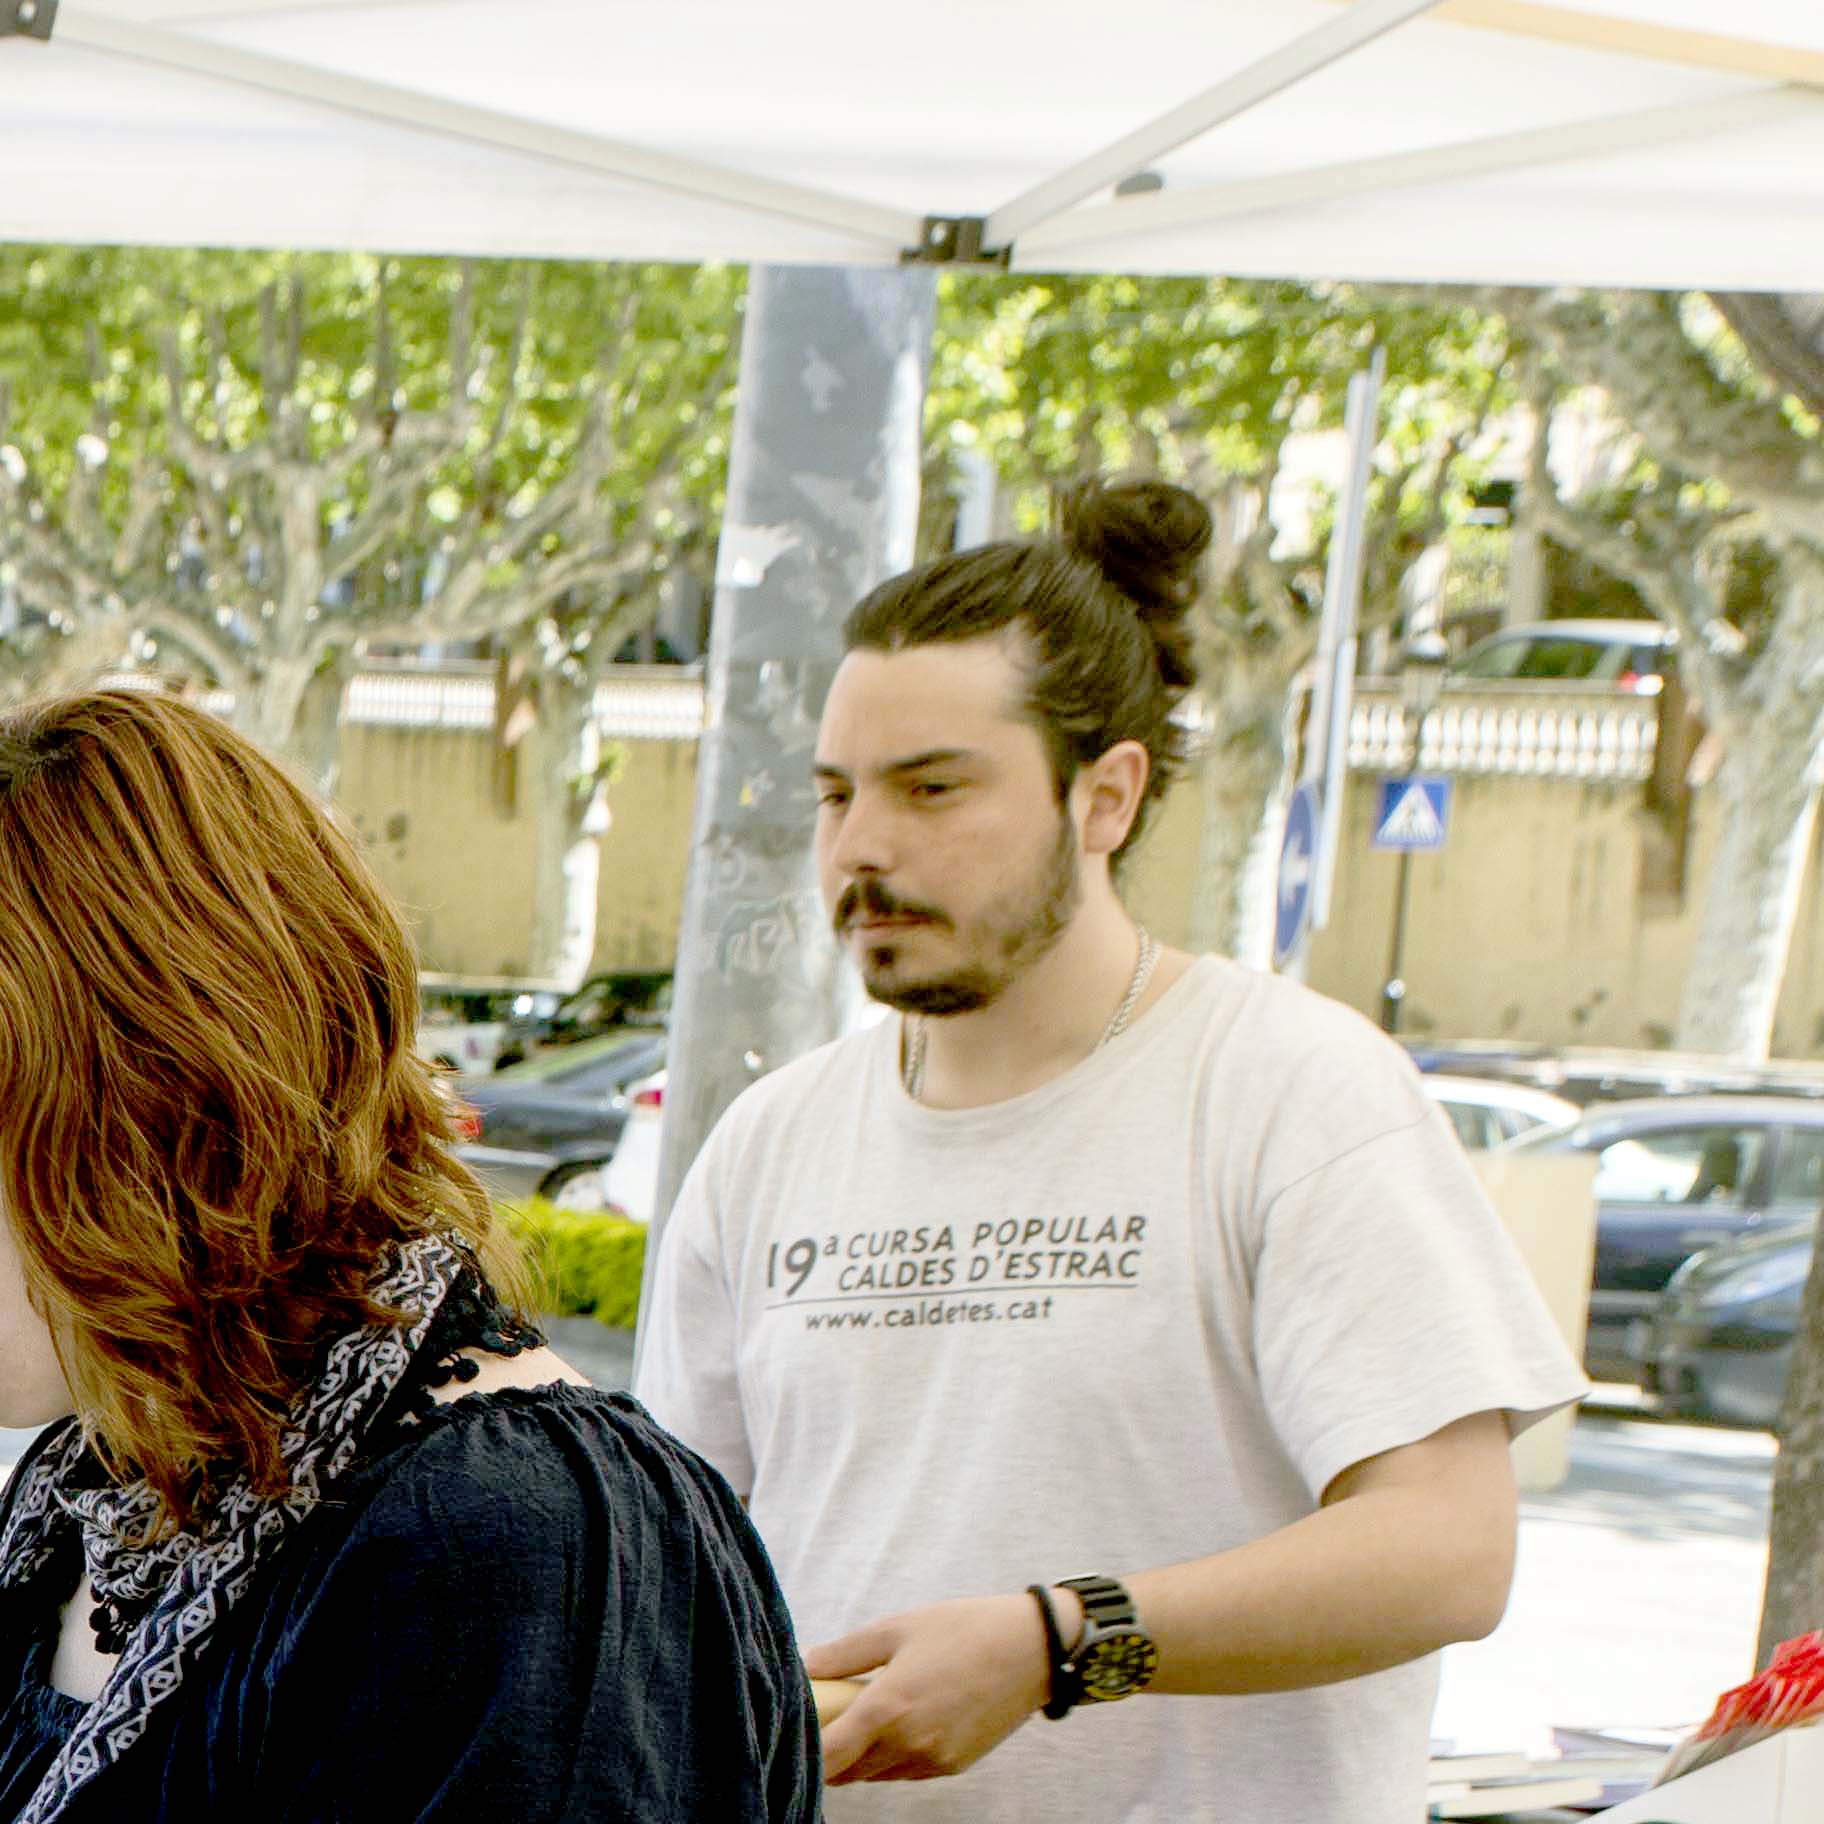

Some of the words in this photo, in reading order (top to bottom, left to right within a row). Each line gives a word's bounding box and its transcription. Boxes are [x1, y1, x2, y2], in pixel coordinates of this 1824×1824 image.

[847, 1224, 952, 1258] CURSA
[973, 1215, 1148, 1246] POPULAR
[839, 1253, 956, 1292] CALDES
[968, 1249, 1144, 1283] D'ESTRAC
[805, 1297, 1054, 1331] www.caldetes.cat
